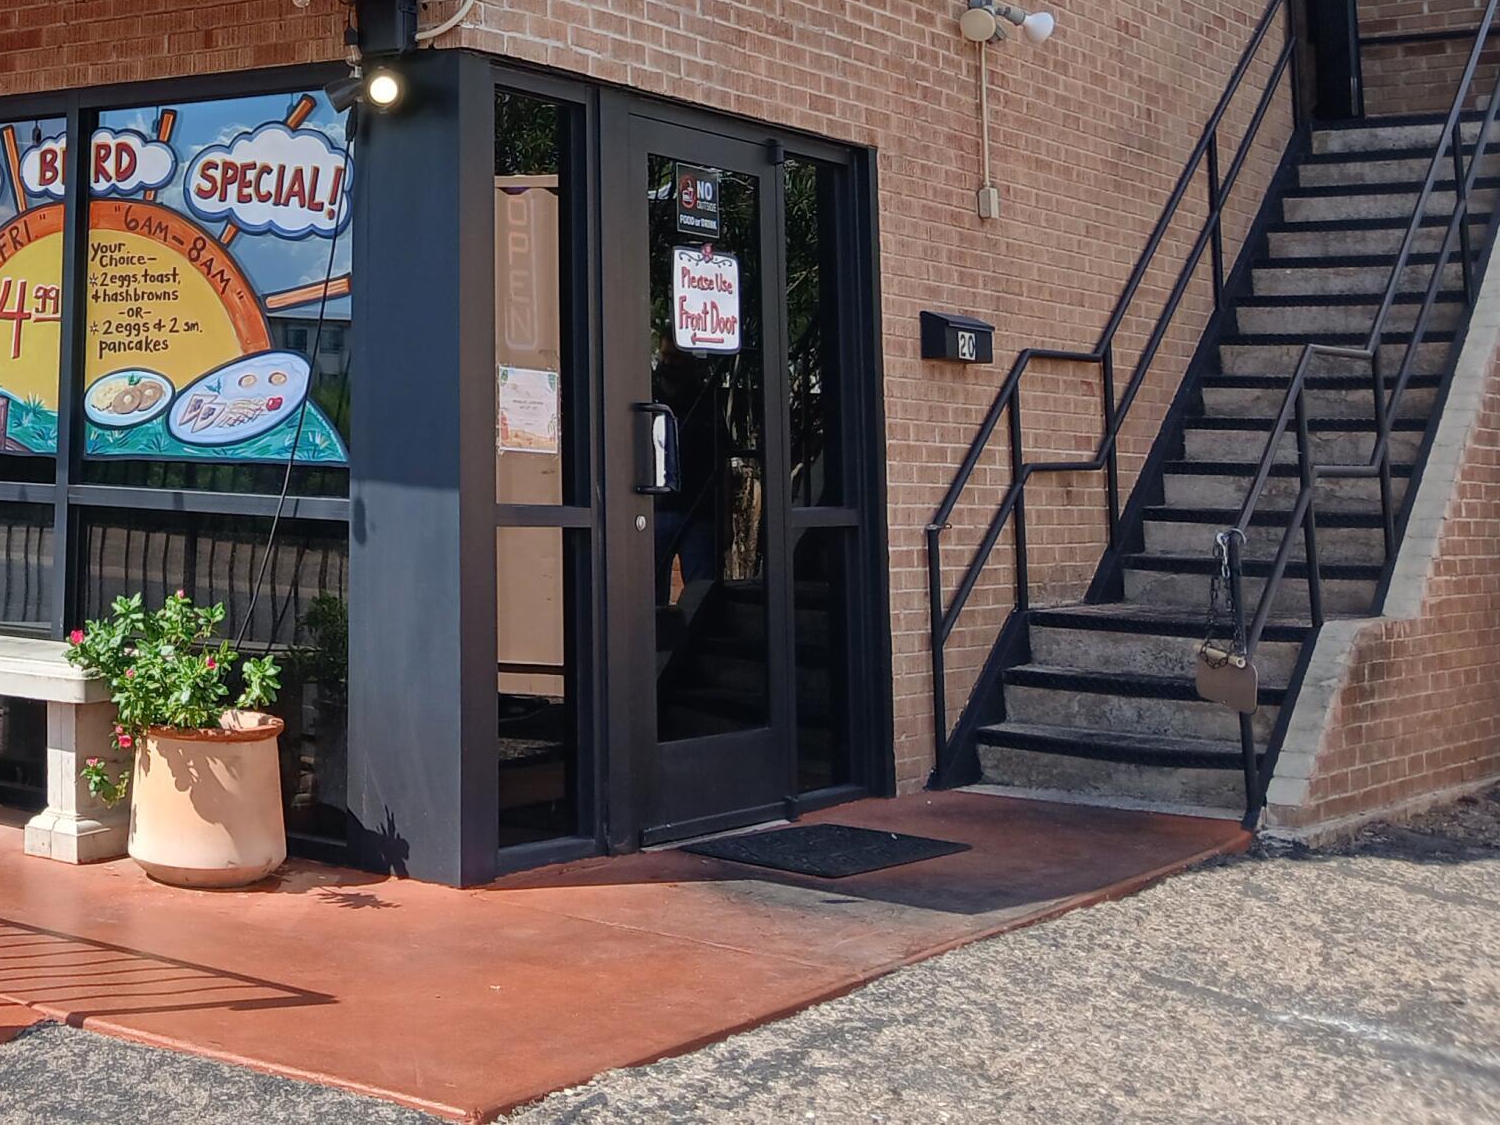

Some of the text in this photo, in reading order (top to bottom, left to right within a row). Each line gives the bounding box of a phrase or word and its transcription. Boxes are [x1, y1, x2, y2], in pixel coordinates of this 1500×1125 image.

[194, 158, 346, 221] SPECIAL!
[696, 180, 713, 201] NO
[680, 213, 695, 225] FOOD
[141, 266, 182, 286] toast,
[681, 265, 733, 295] Please Use
[102, 288, 180, 303] hashbrowns
[678, 295, 738, 336] Front Door
[102, 320, 114, 335] 2
[115, 322, 150, 338] eggs
[168, 317, 180, 334] 2
[98, 335, 170, 360] pancakes
[960, 333, 976, 359] 20
